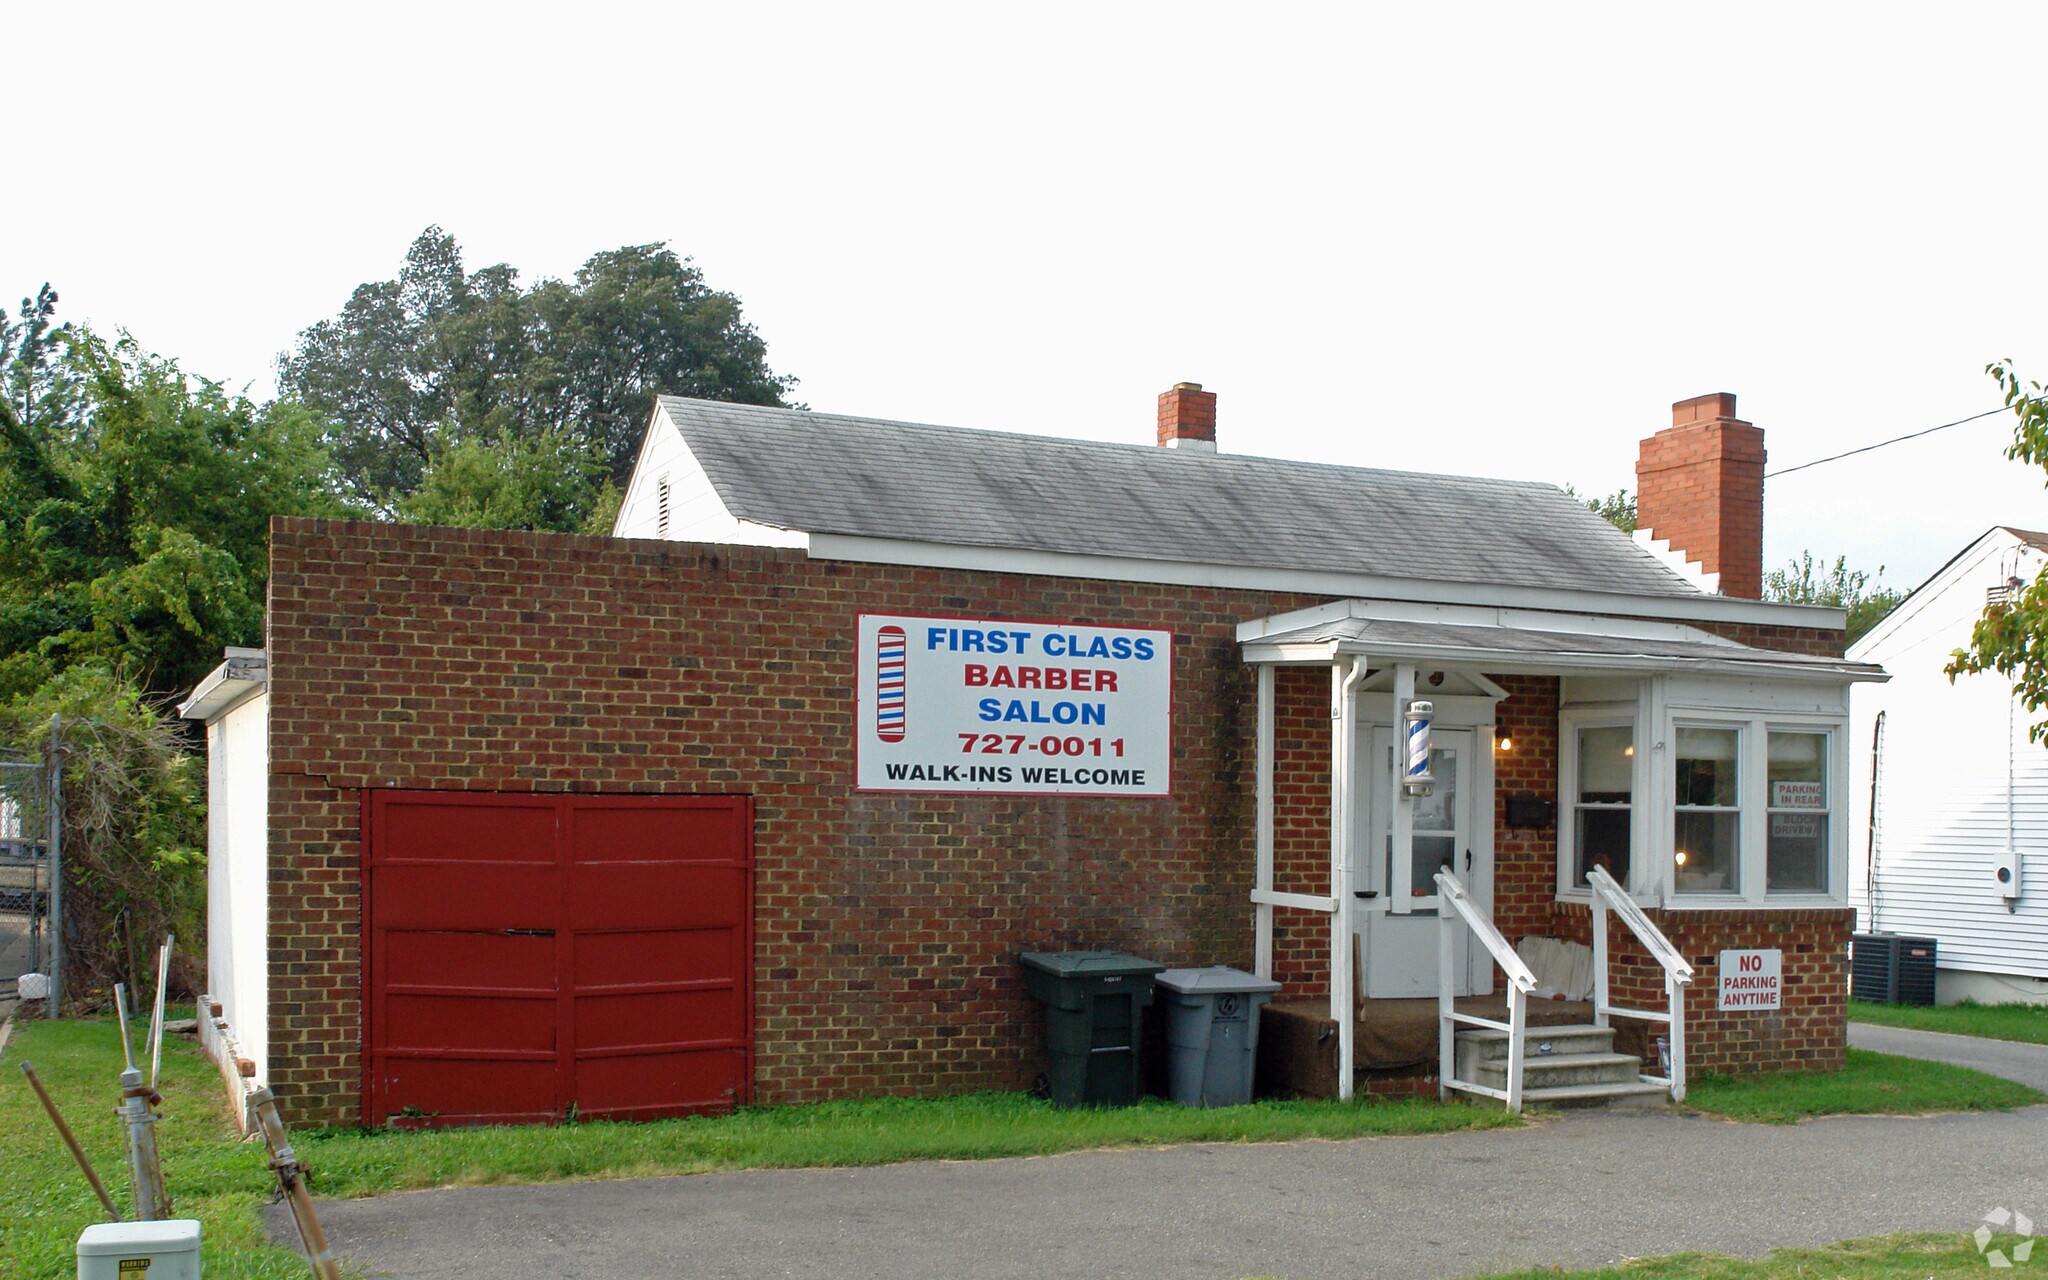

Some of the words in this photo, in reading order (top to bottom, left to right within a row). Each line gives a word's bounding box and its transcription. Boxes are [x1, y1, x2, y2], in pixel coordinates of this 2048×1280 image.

[928, 628, 1031, 654] FIRST
[1043, 633, 1154, 660] CLASS
[965, 664, 1118, 692] BARBER
[978, 698, 1106, 726] SALON
[958, 733, 1124, 757] 727-0011
[886, 764, 1012, 783] WALK-INS
[1021, 767, 1146, 786] WELCOME
[1781, 795, 1791, 804] IN
[1795, 795, 1820, 804] REAR
[1739, 955, 1762, 972] NO
[1724, 976, 1777, 989] PARKING
[1723, 992, 1777, 1006] ANYTIME
